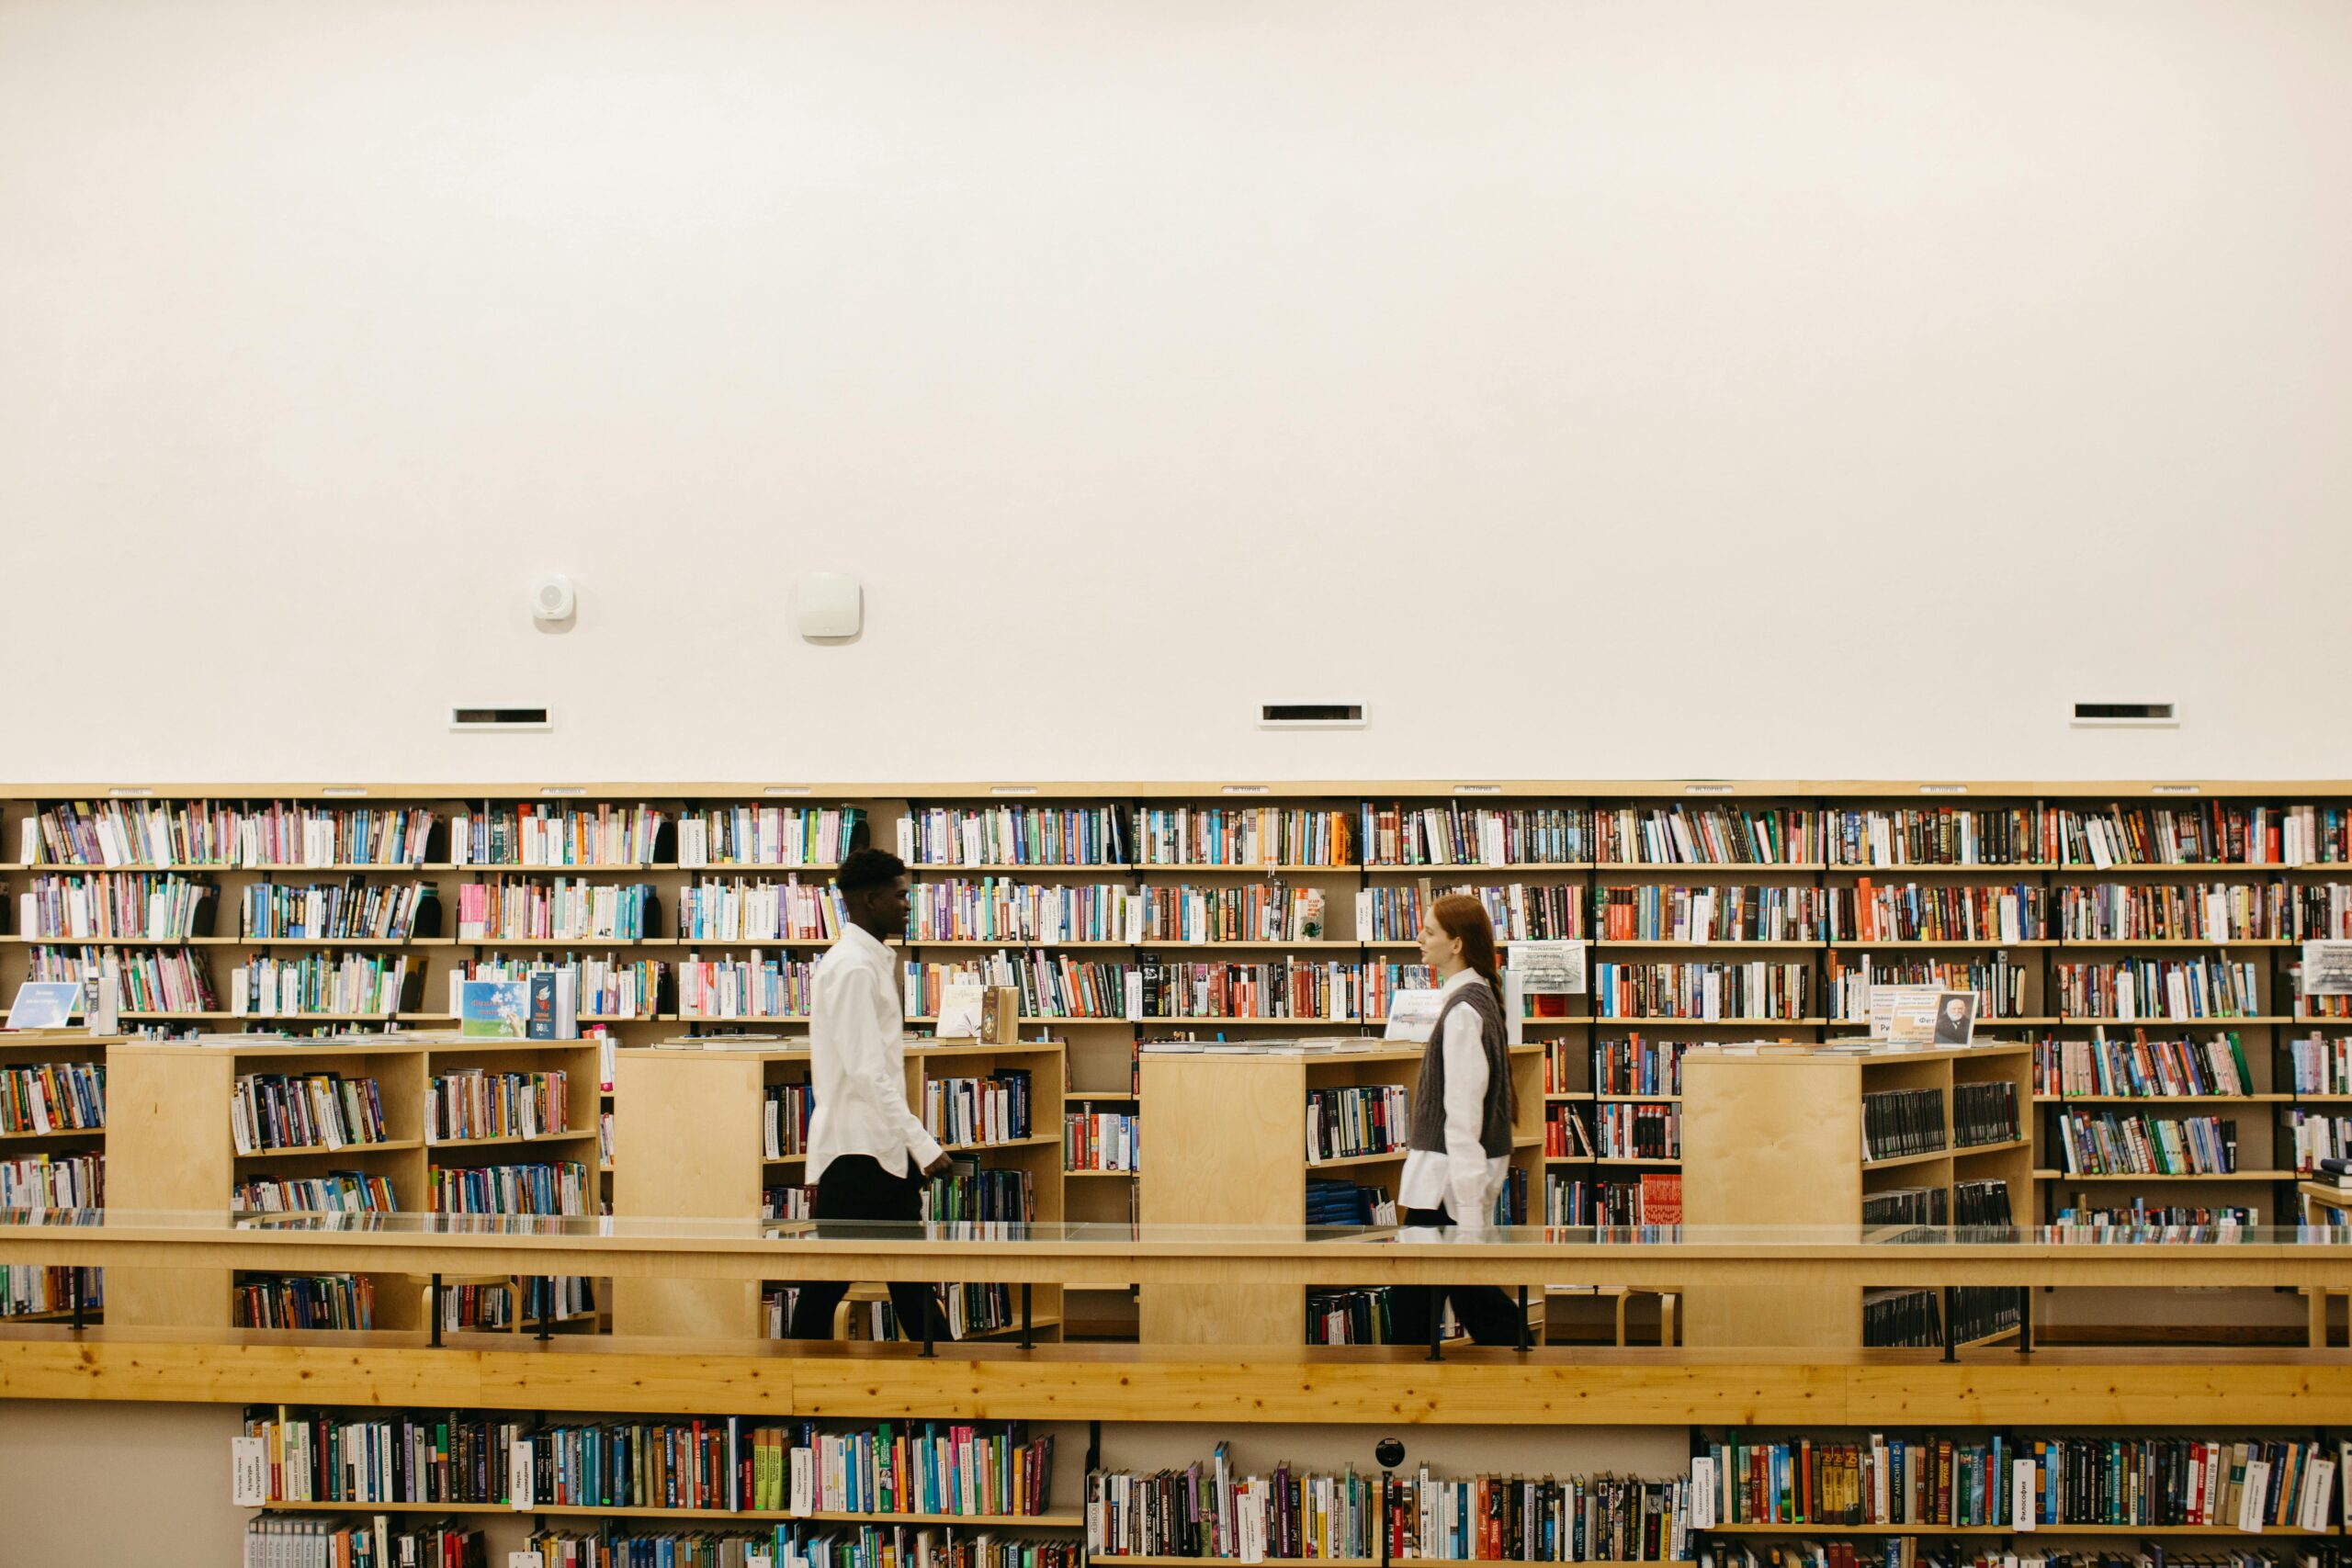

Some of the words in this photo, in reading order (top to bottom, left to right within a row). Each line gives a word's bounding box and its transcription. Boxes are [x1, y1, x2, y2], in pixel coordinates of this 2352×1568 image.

[695, 829, 703, 863] Онкология
[536, 1023, 543, 1032] 56
[2207, 1463, 2216, 1505] ФИЛОСОФИЯ
